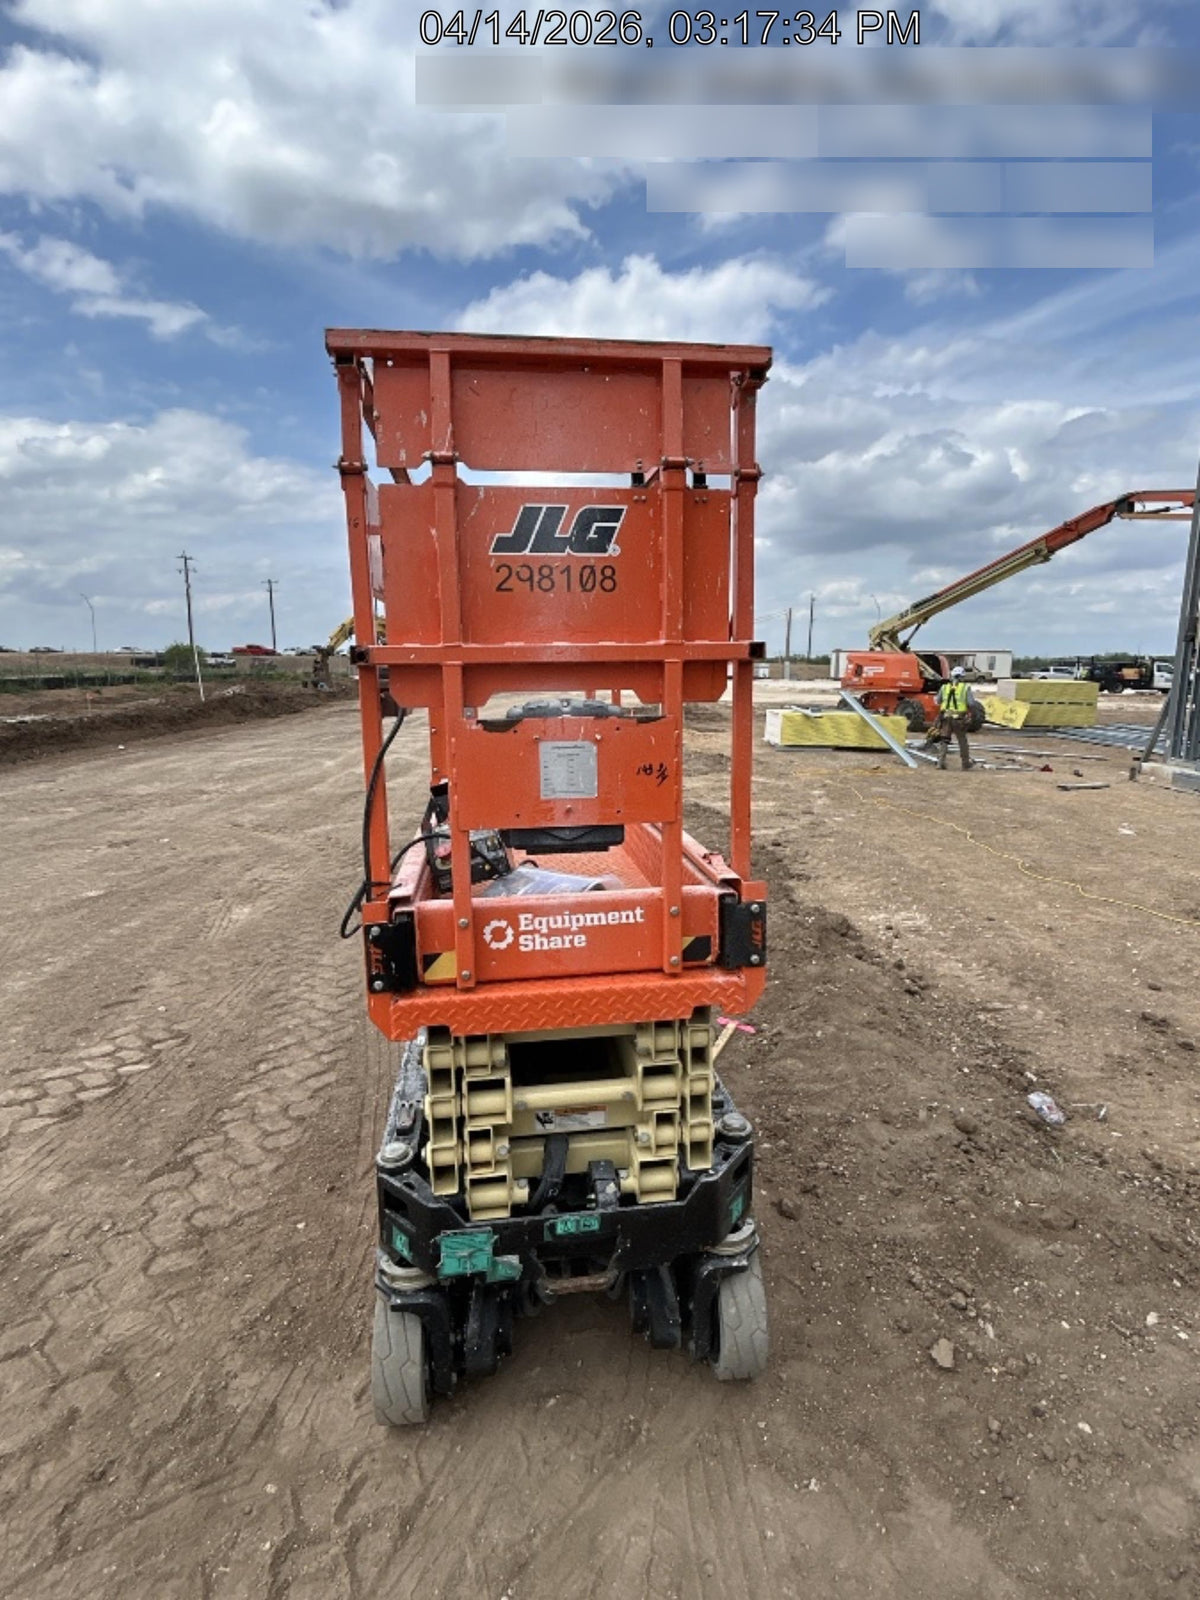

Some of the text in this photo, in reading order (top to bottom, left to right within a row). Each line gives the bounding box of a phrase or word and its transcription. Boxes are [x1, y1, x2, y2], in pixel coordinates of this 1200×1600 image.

[488, 503, 628, 557] JLG
[495, 564, 617, 592] 298108
[518, 905, 645, 933] Equipment
[518, 933, 587, 951] Share
